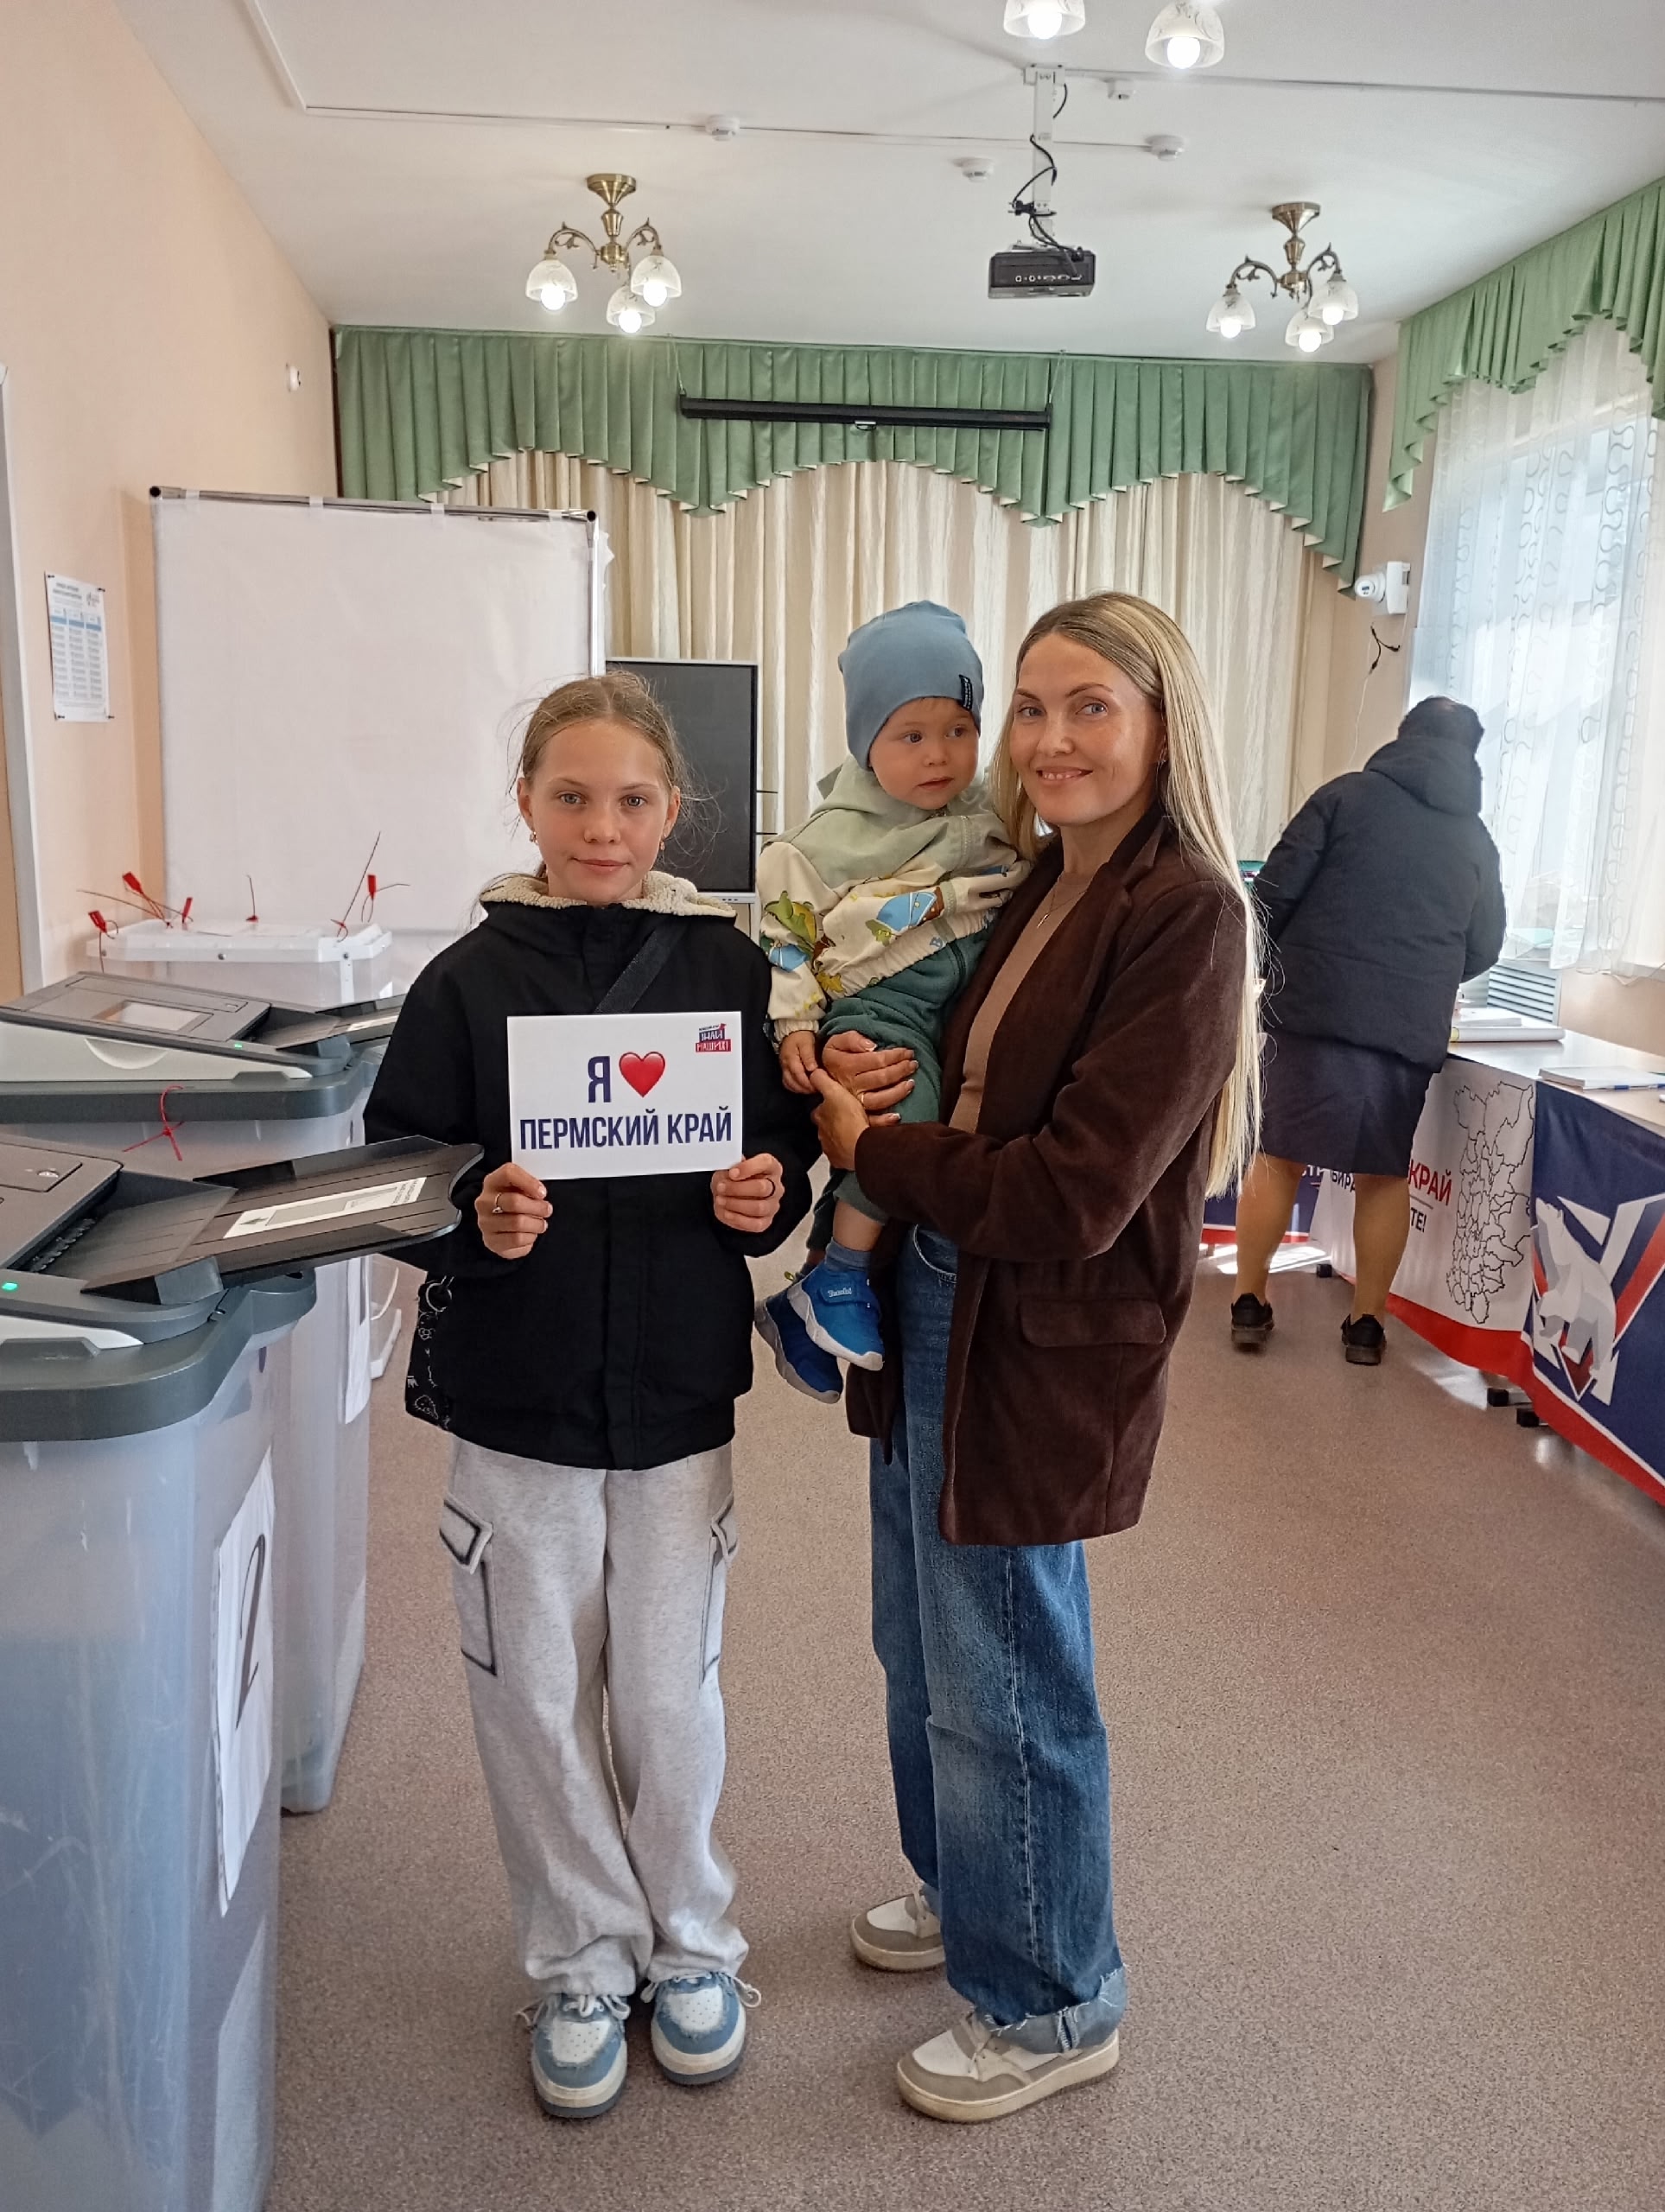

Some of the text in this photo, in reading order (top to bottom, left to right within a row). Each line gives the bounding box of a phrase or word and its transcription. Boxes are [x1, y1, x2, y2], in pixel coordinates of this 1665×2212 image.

[587, 1055, 612, 1103] Я
[519, 1105, 732, 1150] ПЕРМСКИЙ КРАЙ
[1408, 1159, 1452, 1206] КРАЙ
[236, 1533, 265, 1729] 2
